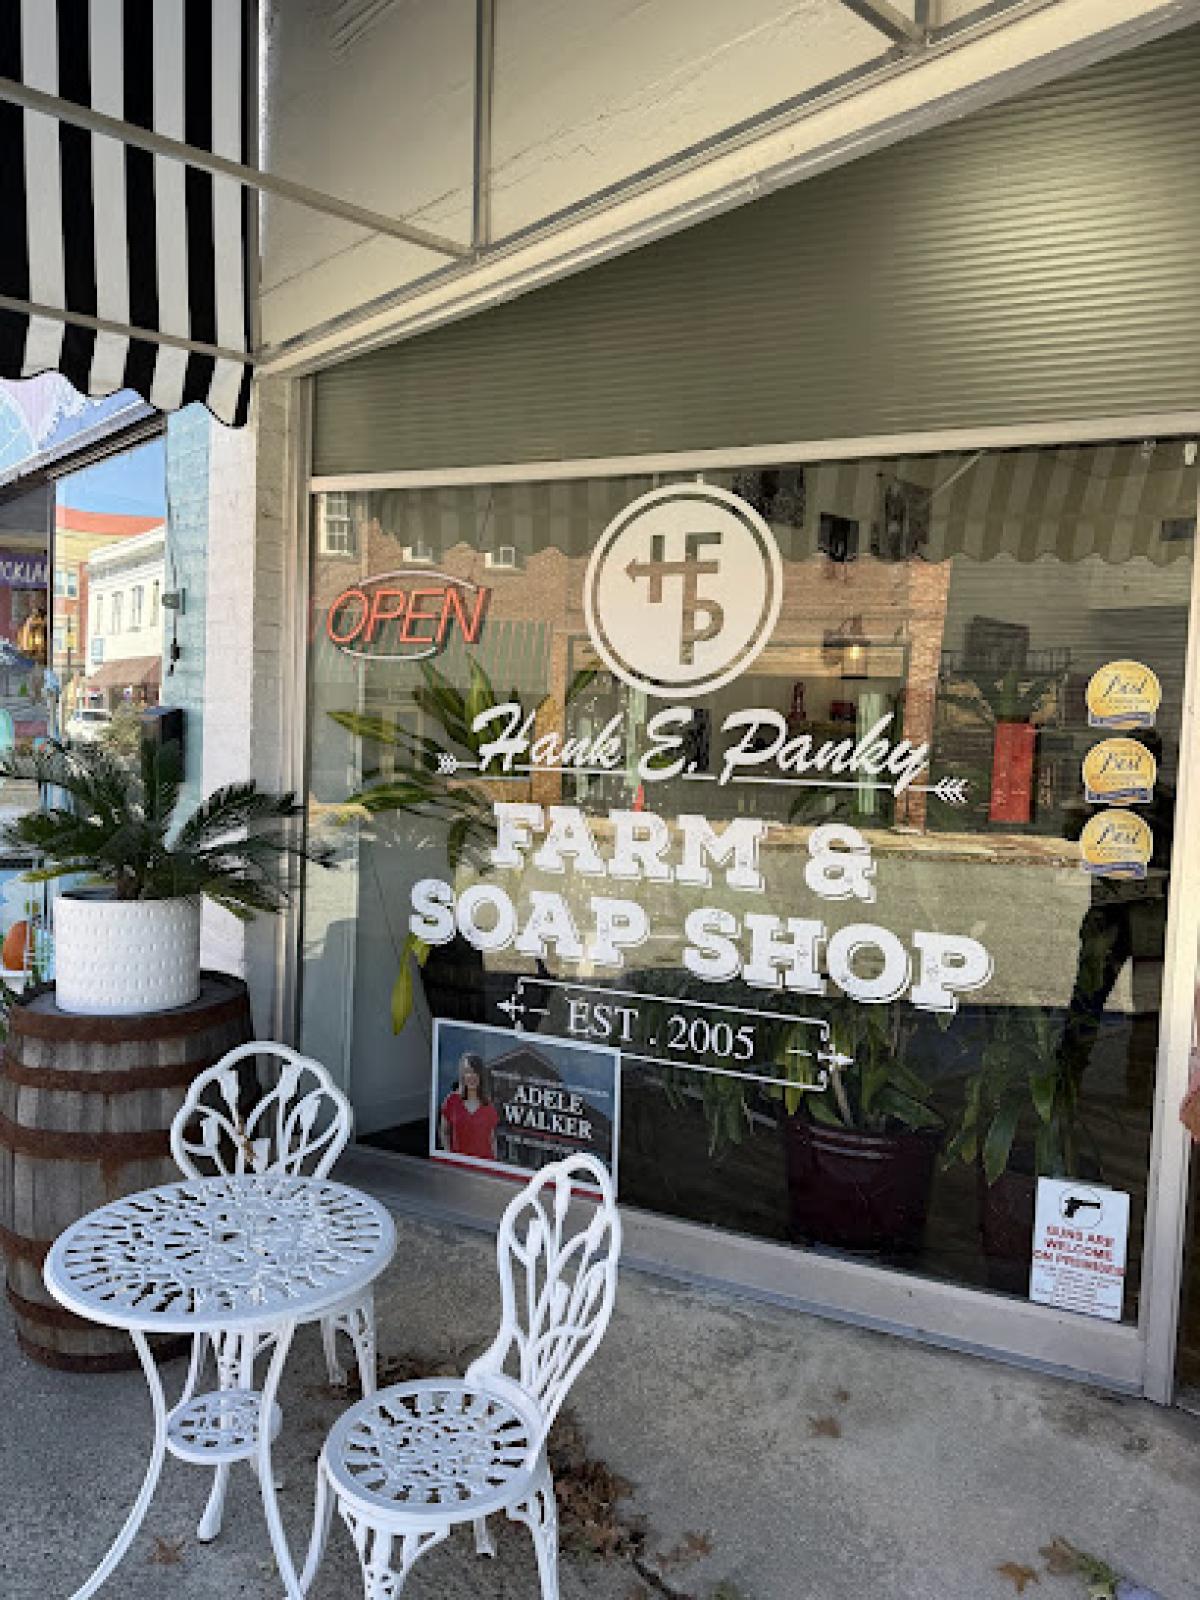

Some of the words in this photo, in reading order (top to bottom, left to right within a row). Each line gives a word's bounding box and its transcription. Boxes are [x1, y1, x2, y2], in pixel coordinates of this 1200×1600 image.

[326, 587, 488, 645] OPEN
[472, 703, 624, 773] Hank
[637, 707, 699, 782] E.
[718, 708, 930, 797] Panky
[490, 802, 767, 894] FARM
[805, 823, 877, 904] &
[409, 878, 650, 969] SOAP
[683, 907, 995, 1015] SHOP
[666, 1016, 756, 1061] 2005
[503, 1102, 593, 1141] WALKER
[514, 1084, 583, 1116] ADELE
